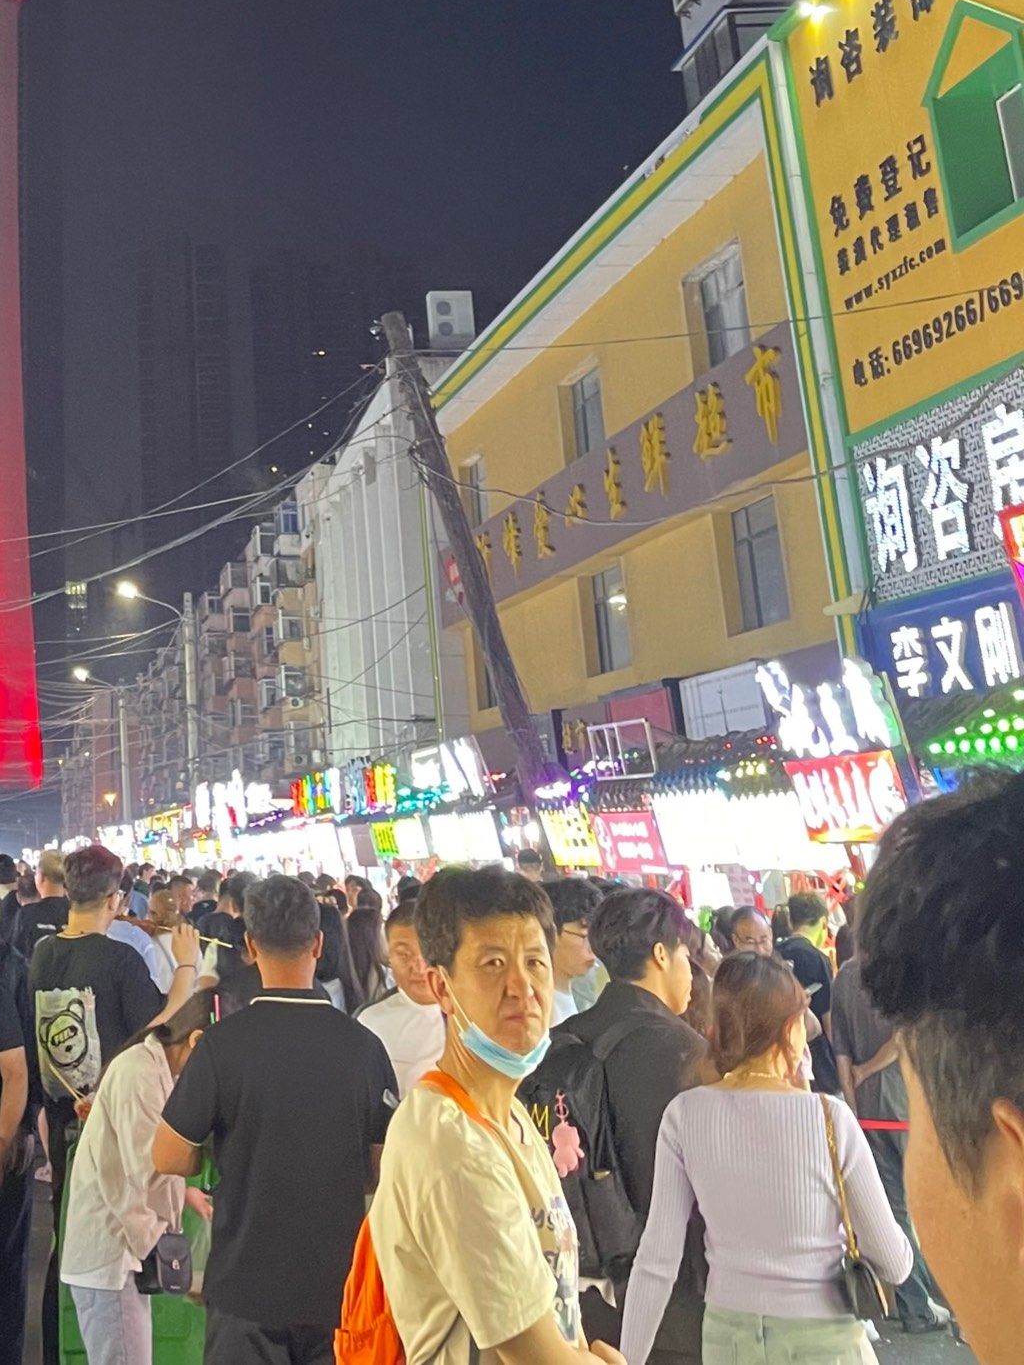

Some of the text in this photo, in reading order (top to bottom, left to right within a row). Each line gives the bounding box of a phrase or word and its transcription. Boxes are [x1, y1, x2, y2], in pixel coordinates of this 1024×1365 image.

[830, 134, 931, 237] 免费登记
[844, 238, 946, 310] www.syxzfc.com
[889, 602, 1020, 697] 李文刚
